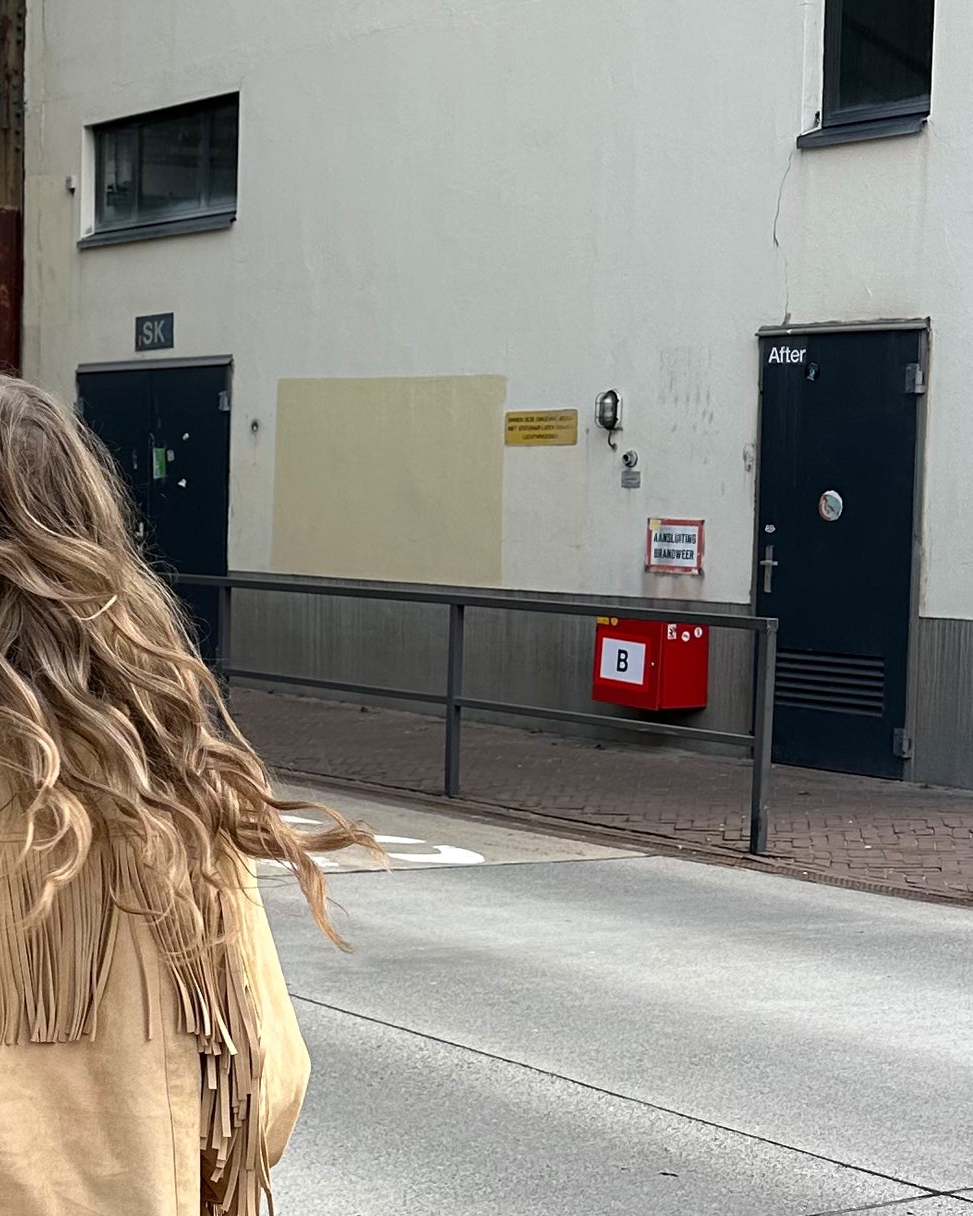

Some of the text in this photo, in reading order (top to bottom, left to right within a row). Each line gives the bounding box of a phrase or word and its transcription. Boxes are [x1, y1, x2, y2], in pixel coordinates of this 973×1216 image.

[768, 346, 807, 364] After
[653, 532, 697, 545] AANSLUITING
[653, 548, 695, 560] BRANDWEER
[616, 648, 629, 673] B
